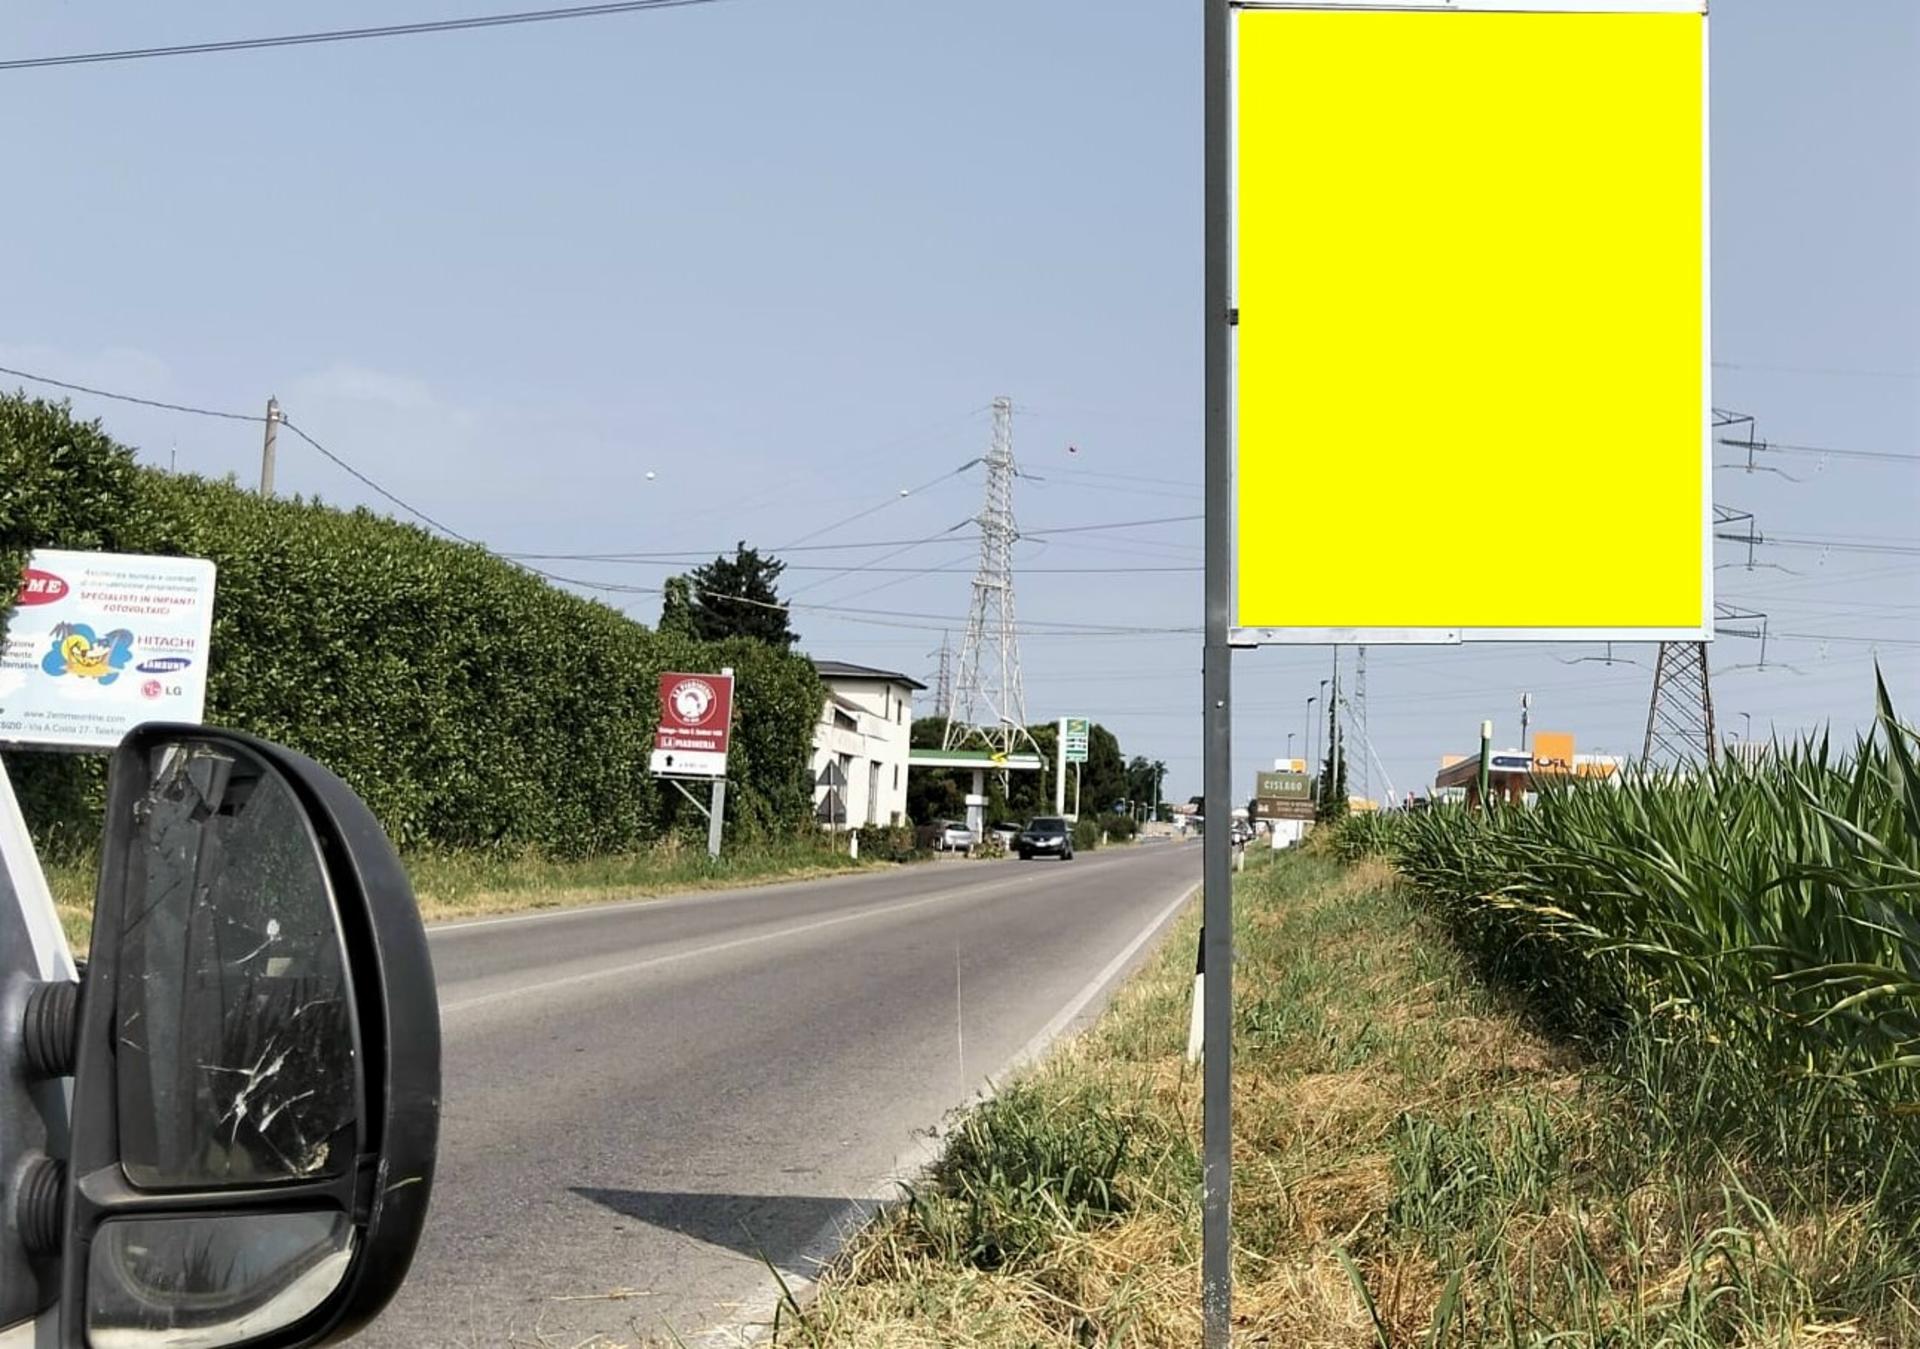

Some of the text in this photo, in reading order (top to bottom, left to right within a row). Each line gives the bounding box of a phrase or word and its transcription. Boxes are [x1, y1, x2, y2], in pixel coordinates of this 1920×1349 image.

[80, 591, 196, 606] SPECIALISTI IN IMPIANTI
[103, 604, 171, 615] FOTOVOLTAICI
[137, 635, 195, 648] HITACHI
[165, 686, 182, 696] LG
